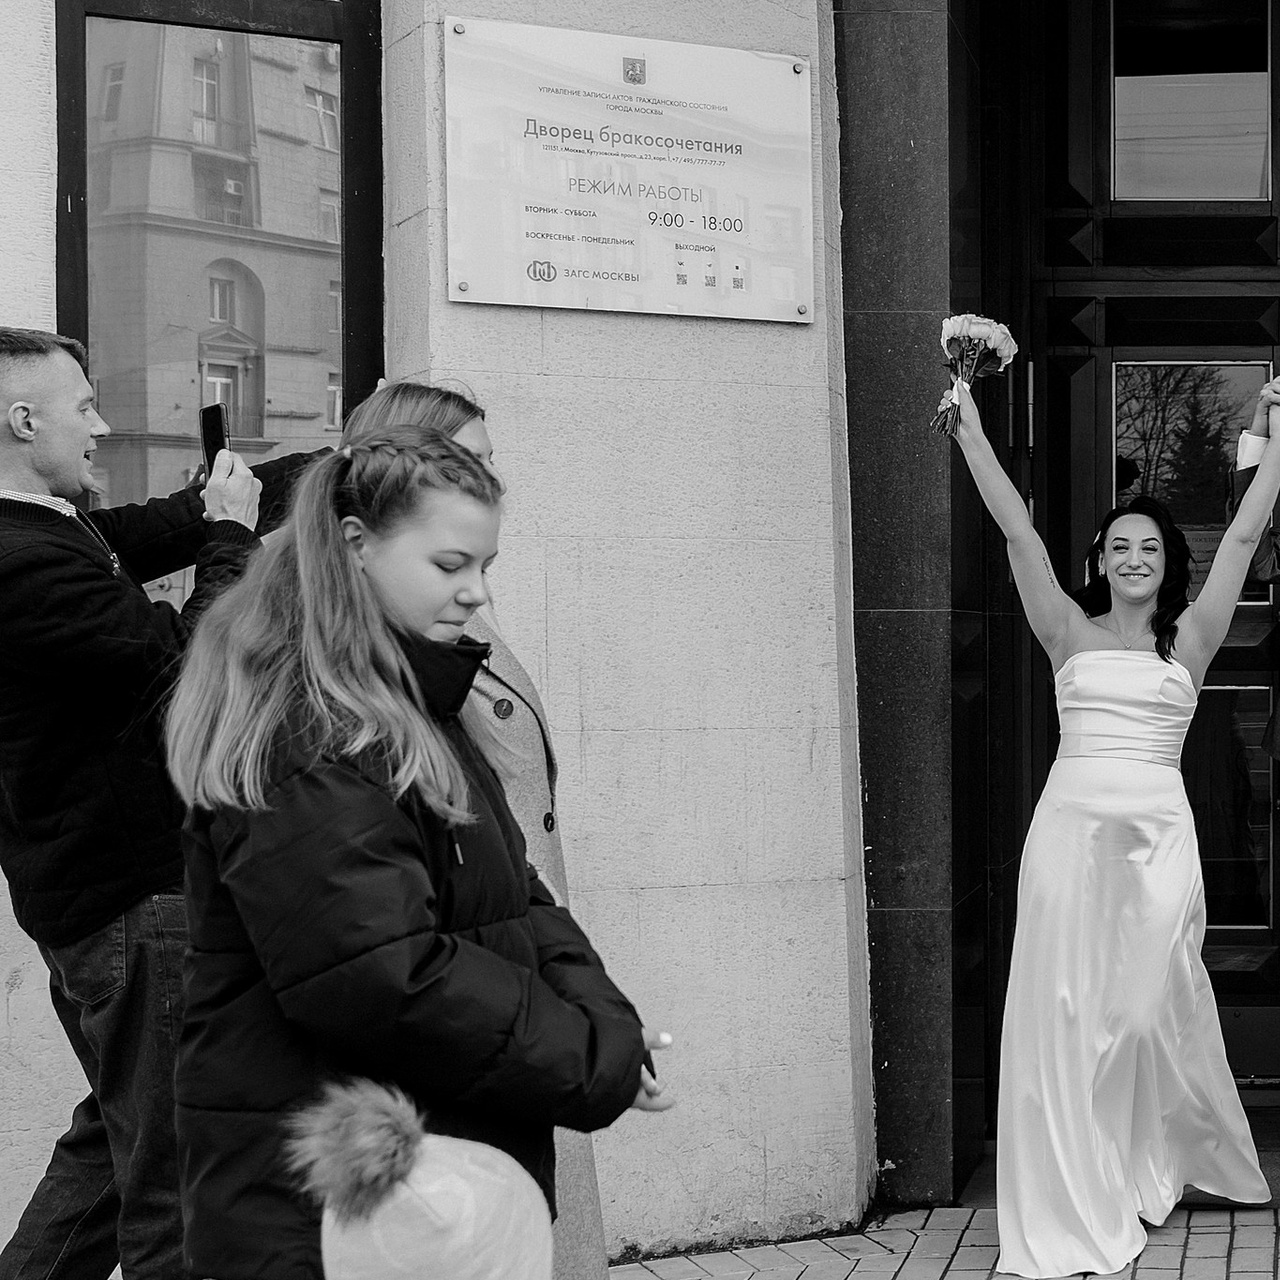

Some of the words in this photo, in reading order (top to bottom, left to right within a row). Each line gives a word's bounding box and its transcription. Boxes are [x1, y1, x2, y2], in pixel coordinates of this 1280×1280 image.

[538, 86, 581, 97] УПРАВЛЕНИЕ
[582, 90, 611, 100] ЗАПИСИ
[612, 94, 633, 102] АКТОВ
[636, 96, 688, 108] ГРАЖДАНСКОГО
[688, 102, 728, 112] СОСТОЯНИЯ
[606, 104, 633, 113] ГОРОДА
[634, 106, 664, 116] МОСКВЫ
[523, 118, 594, 144] Дворец
[599, 125, 743, 155] бракосочетания
[568, 177, 632, 197] РЕЖИМ
[638, 183, 702, 203] РАБОТЫ
[525, 205, 559, 215] ВТОРНИК
[564, 208, 598, 218] СУББОТА
[648, 211, 684, 228] 9:00
[701, 215, 743, 233] 18:00
[525, 231, 576, 242] ВОСКРЕСЕНЬЕ
[581, 235, 636, 246] ПОНЕДЕЛЬНИК
[675, 243, 716, 253] ВЫХОДНОЙ
[563, 268, 590, 279] ЗАГС
[591, 270, 640, 282] МОСКВЫ
